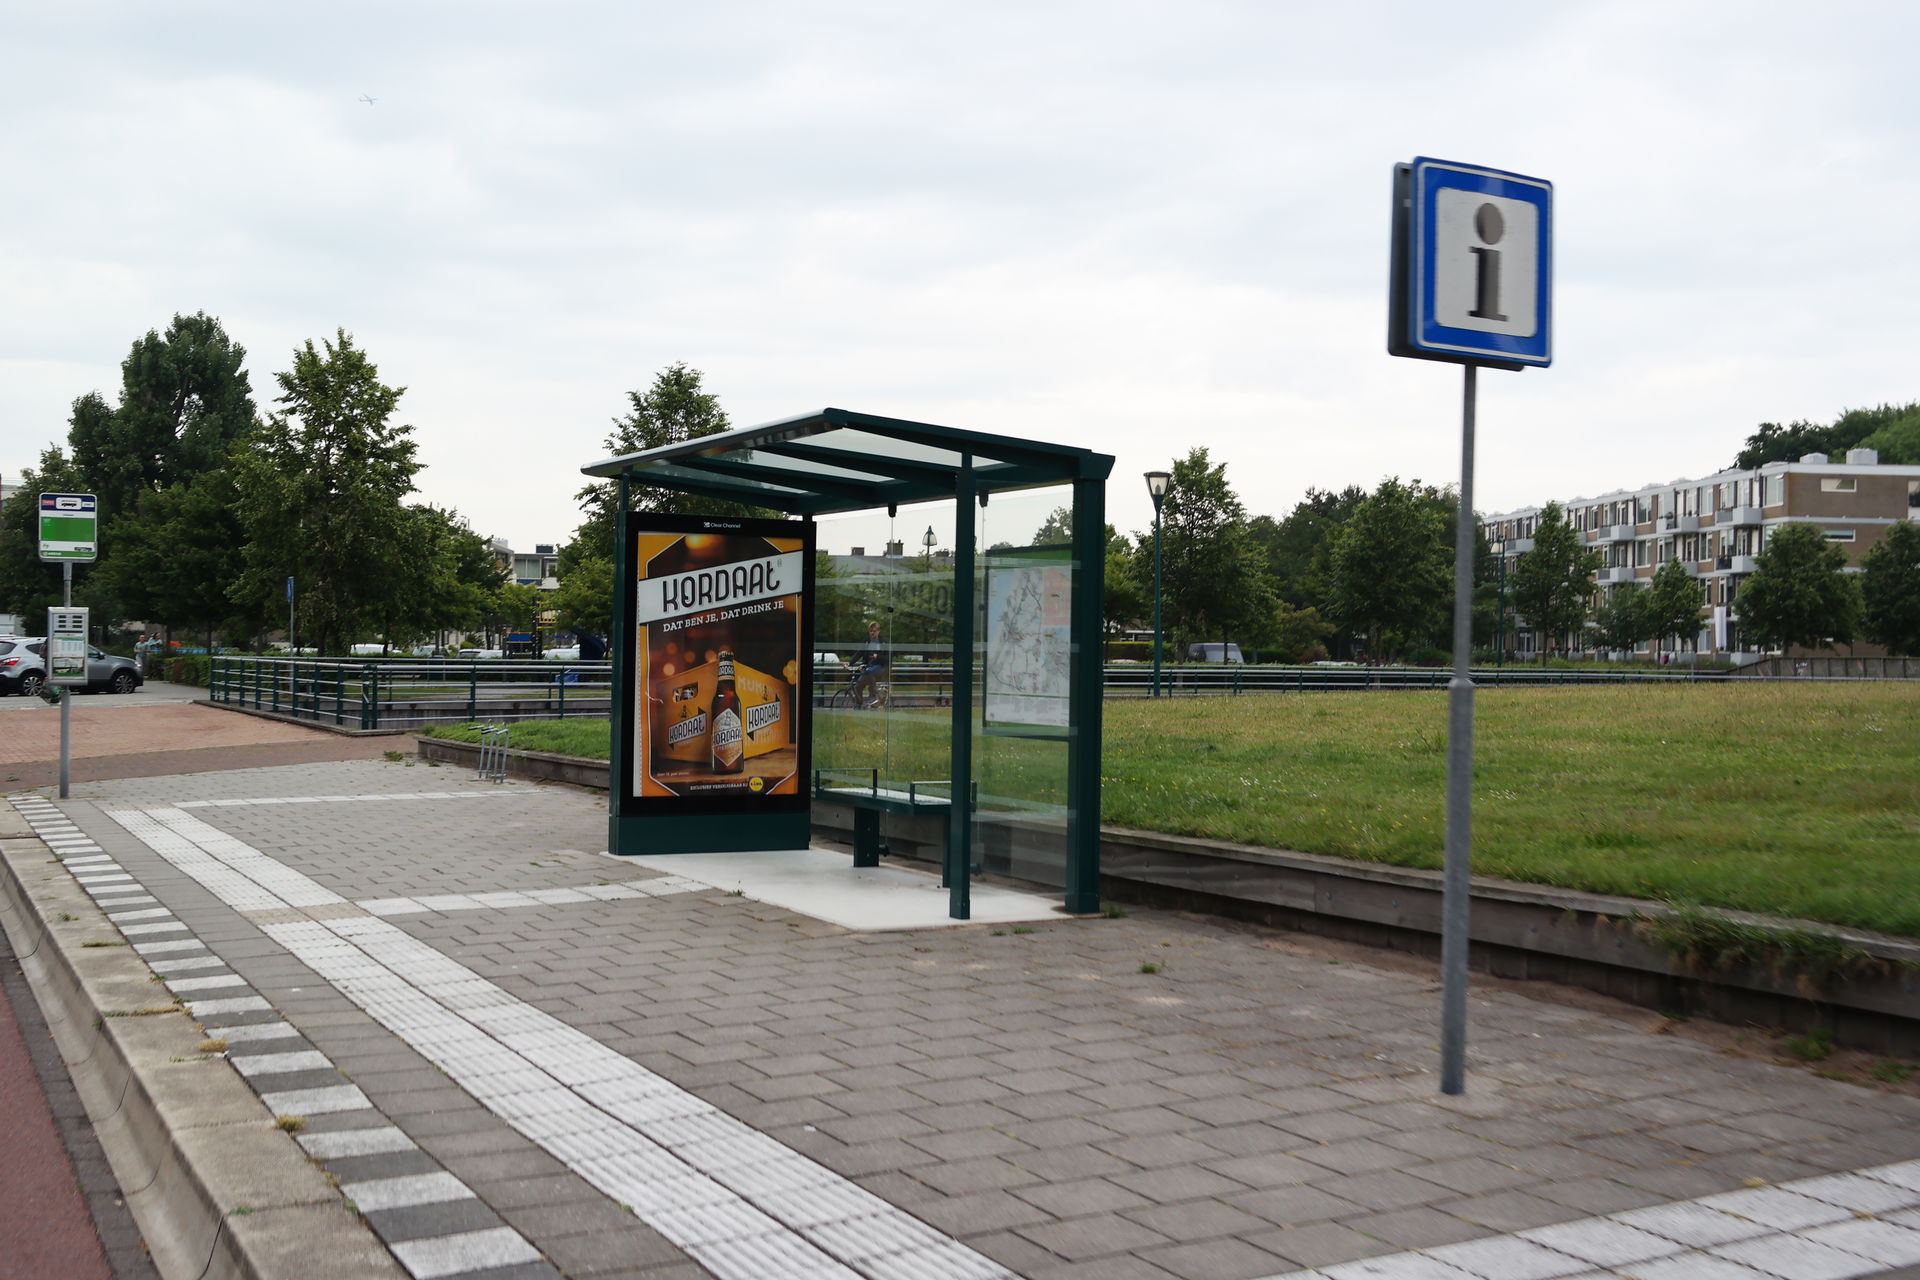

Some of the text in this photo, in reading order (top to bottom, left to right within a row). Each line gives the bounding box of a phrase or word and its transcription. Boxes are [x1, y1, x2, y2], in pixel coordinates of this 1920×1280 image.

[663, 600, 784, 632] DAT BEN JE, DAT DRINK JE
